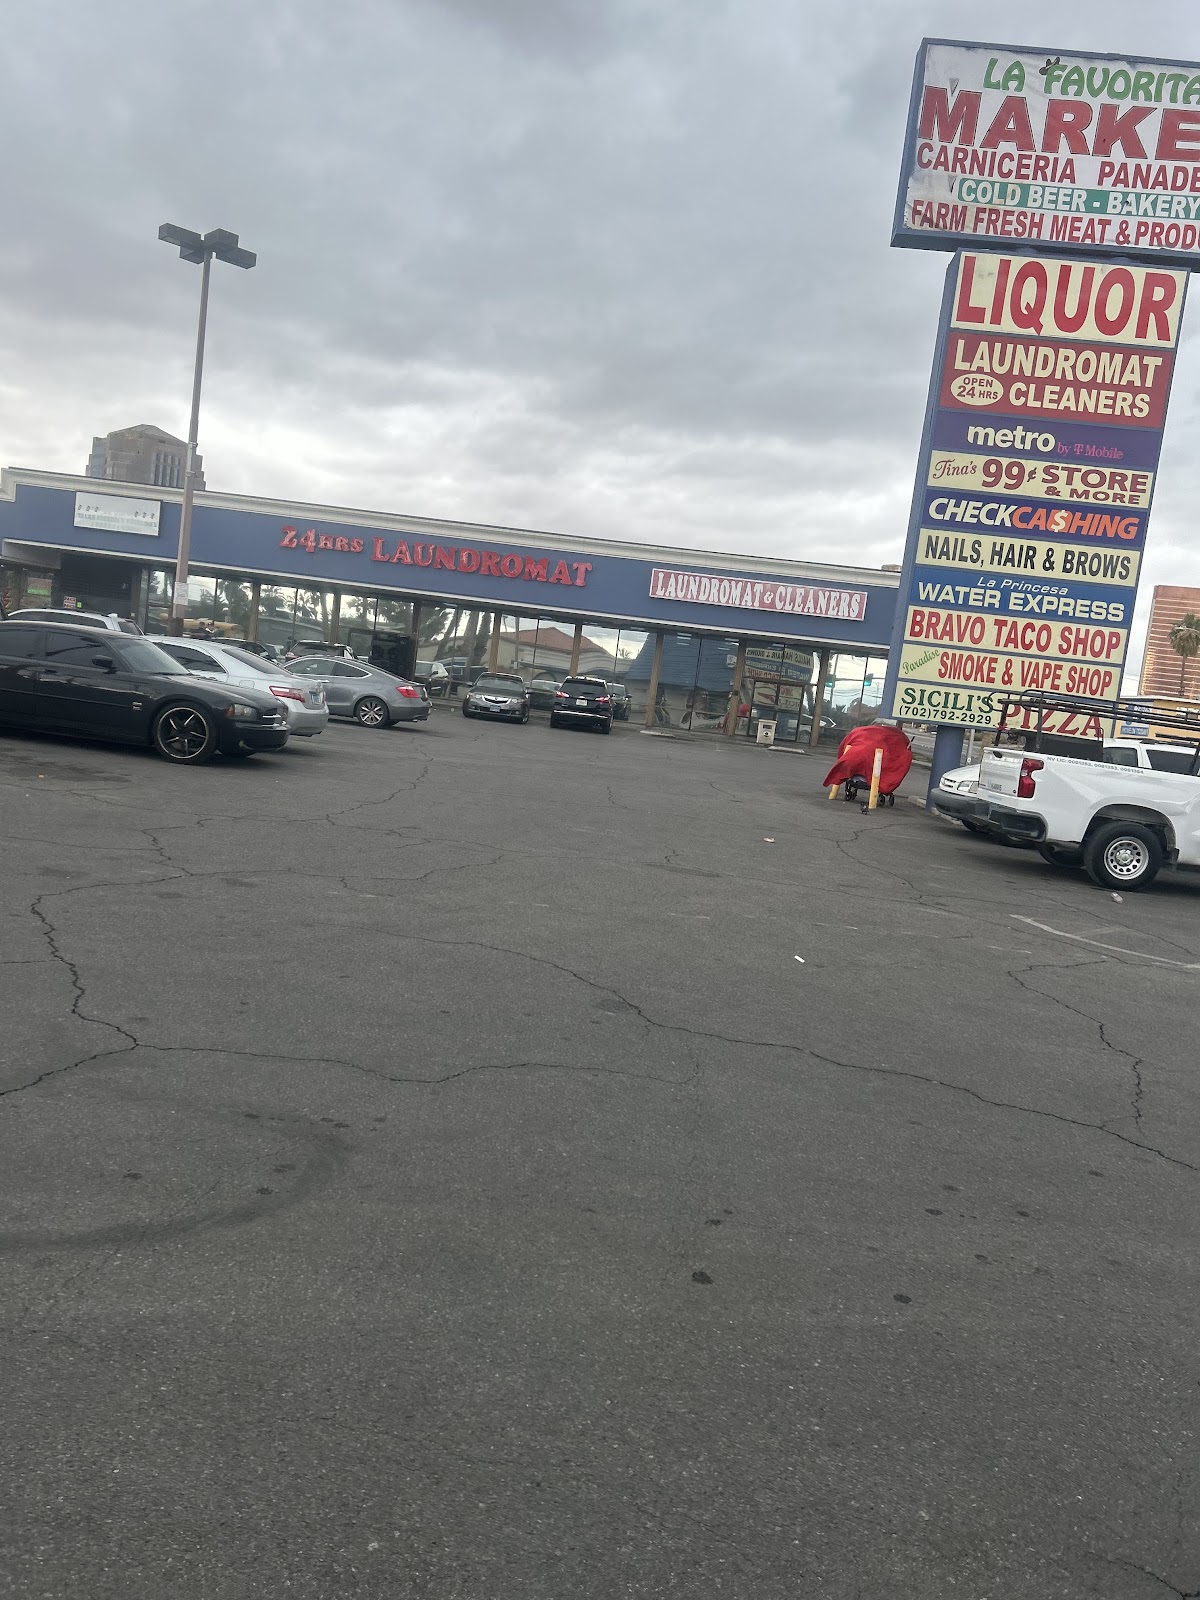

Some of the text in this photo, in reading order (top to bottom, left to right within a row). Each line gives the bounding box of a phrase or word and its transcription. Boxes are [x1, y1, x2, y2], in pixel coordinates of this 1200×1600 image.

[983, 57, 1200, 105] LA FAVORITA
[917, 142, 1076, 184] CARNICERIA
[961, 180, 1022, 205] COLD
[1027, 185, 1088, 211] BEER
[1106, 191, 1200, 219] BAKERY
[911, 199, 1200, 250] FARM FRESH MEAT & PROD
[955, 255, 1177, 342] LIQUOR
[954, 339, 1163, 388] LAUNDROMAT
[963, 377, 994, 388] OPEN
[956, 385, 999, 400] 24 HRS
[1009, 381, 1151, 419] CLEANERS
[966, 425, 1056, 453] metro
[1057, 442, 1072, 457] by
[932, 458, 977, 480] Tina's
[1041, 464, 1149, 494] STORE
[1044, 486, 1141, 505] & MORE
[371, 536, 593, 587] LAUNDROMAT
[924, 534, 1131, 581] NAILS, HAIR & BROWS
[656, 572, 764, 608] LAUNDROMAT
[775, 585, 861, 618] CLEANERS
[918, 581, 1125, 623] WATER EXPRESS
[976, 576, 1069, 596] La Princesa
[909, 609, 1121, 660] BRAVO TACO SHOP
[902, 649, 941, 676] Paradise
[938, 651, 1113, 697] SMOKE & VAPE SHOP
[899, 704, 992, 725] (702)792-2929
[901, 687, 994, 714] SICILI'S
[997, 698, 1103, 738] PIZZA
